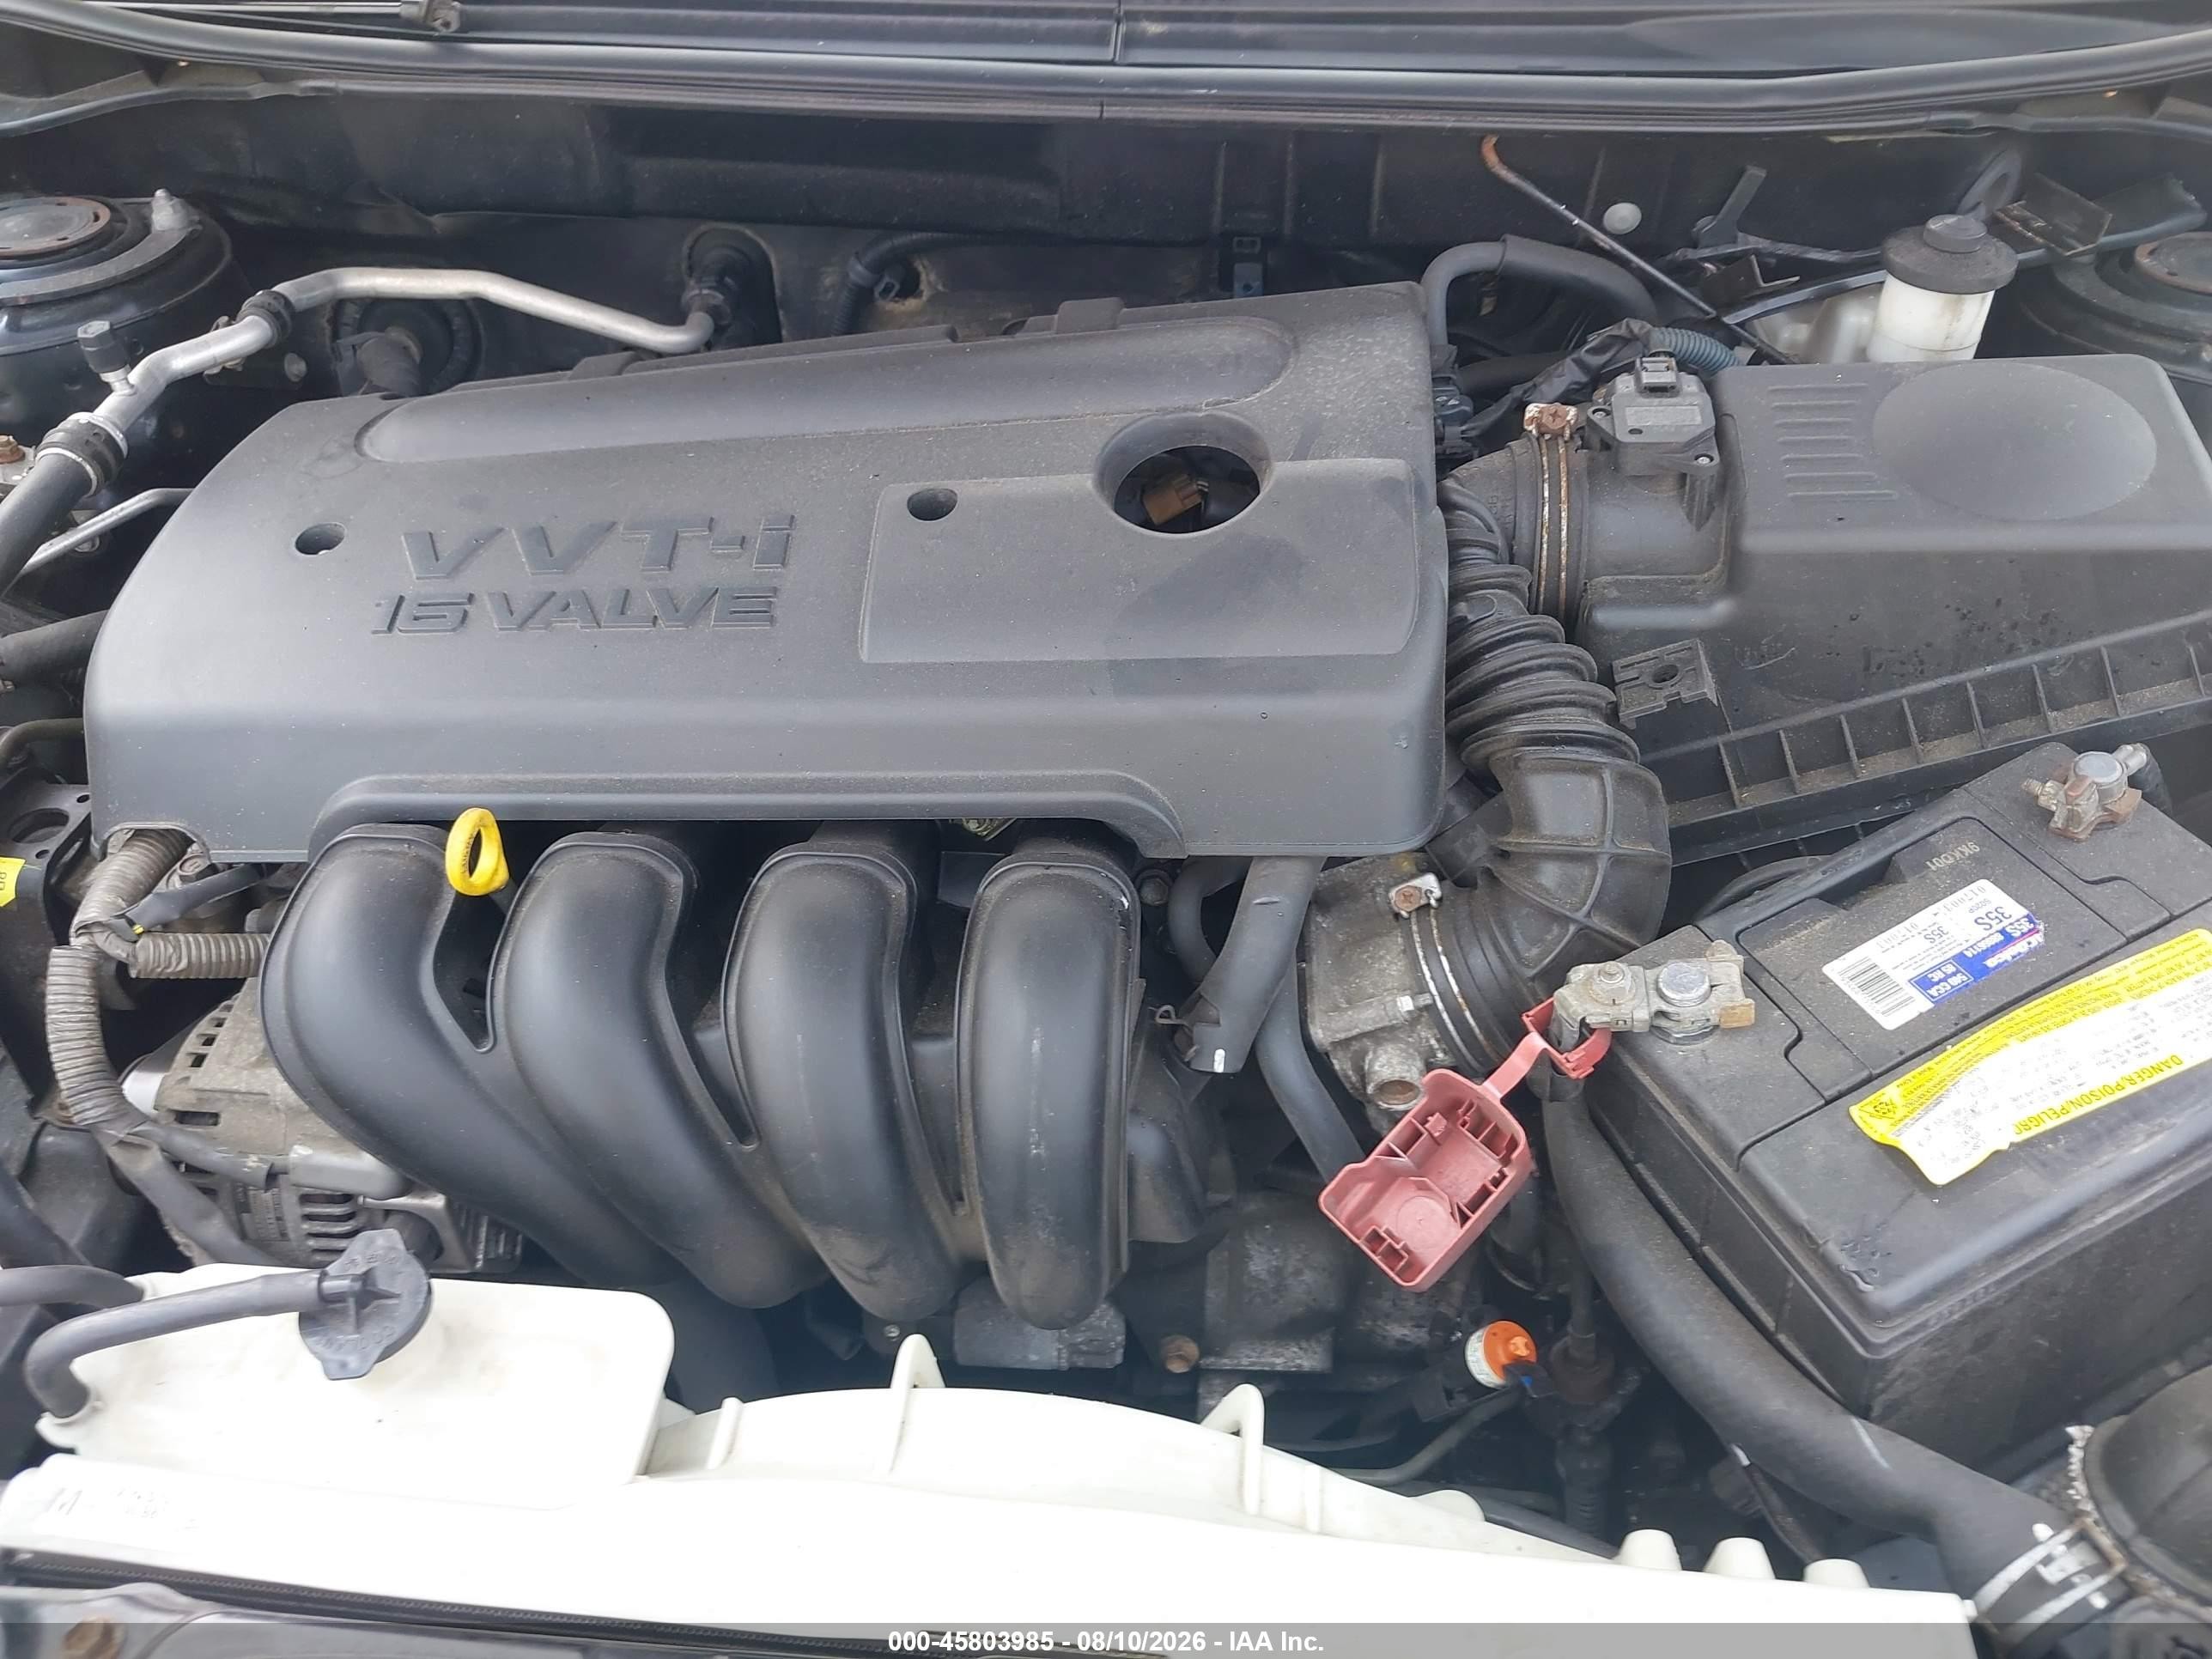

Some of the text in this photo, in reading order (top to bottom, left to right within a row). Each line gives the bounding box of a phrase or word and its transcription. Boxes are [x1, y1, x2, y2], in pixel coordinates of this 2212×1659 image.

[402, 515, 795, 580] VVT-i
[372, 586, 778, 635] 16 VALVE
[1974, 906, 2012, 931] 35S
[2005, 917, 2035, 938] 35S
[1923, 926, 1949, 944] 35S
[1926, 969, 1946, 982] RC
[1925, 981, 1952, 997] CCA
